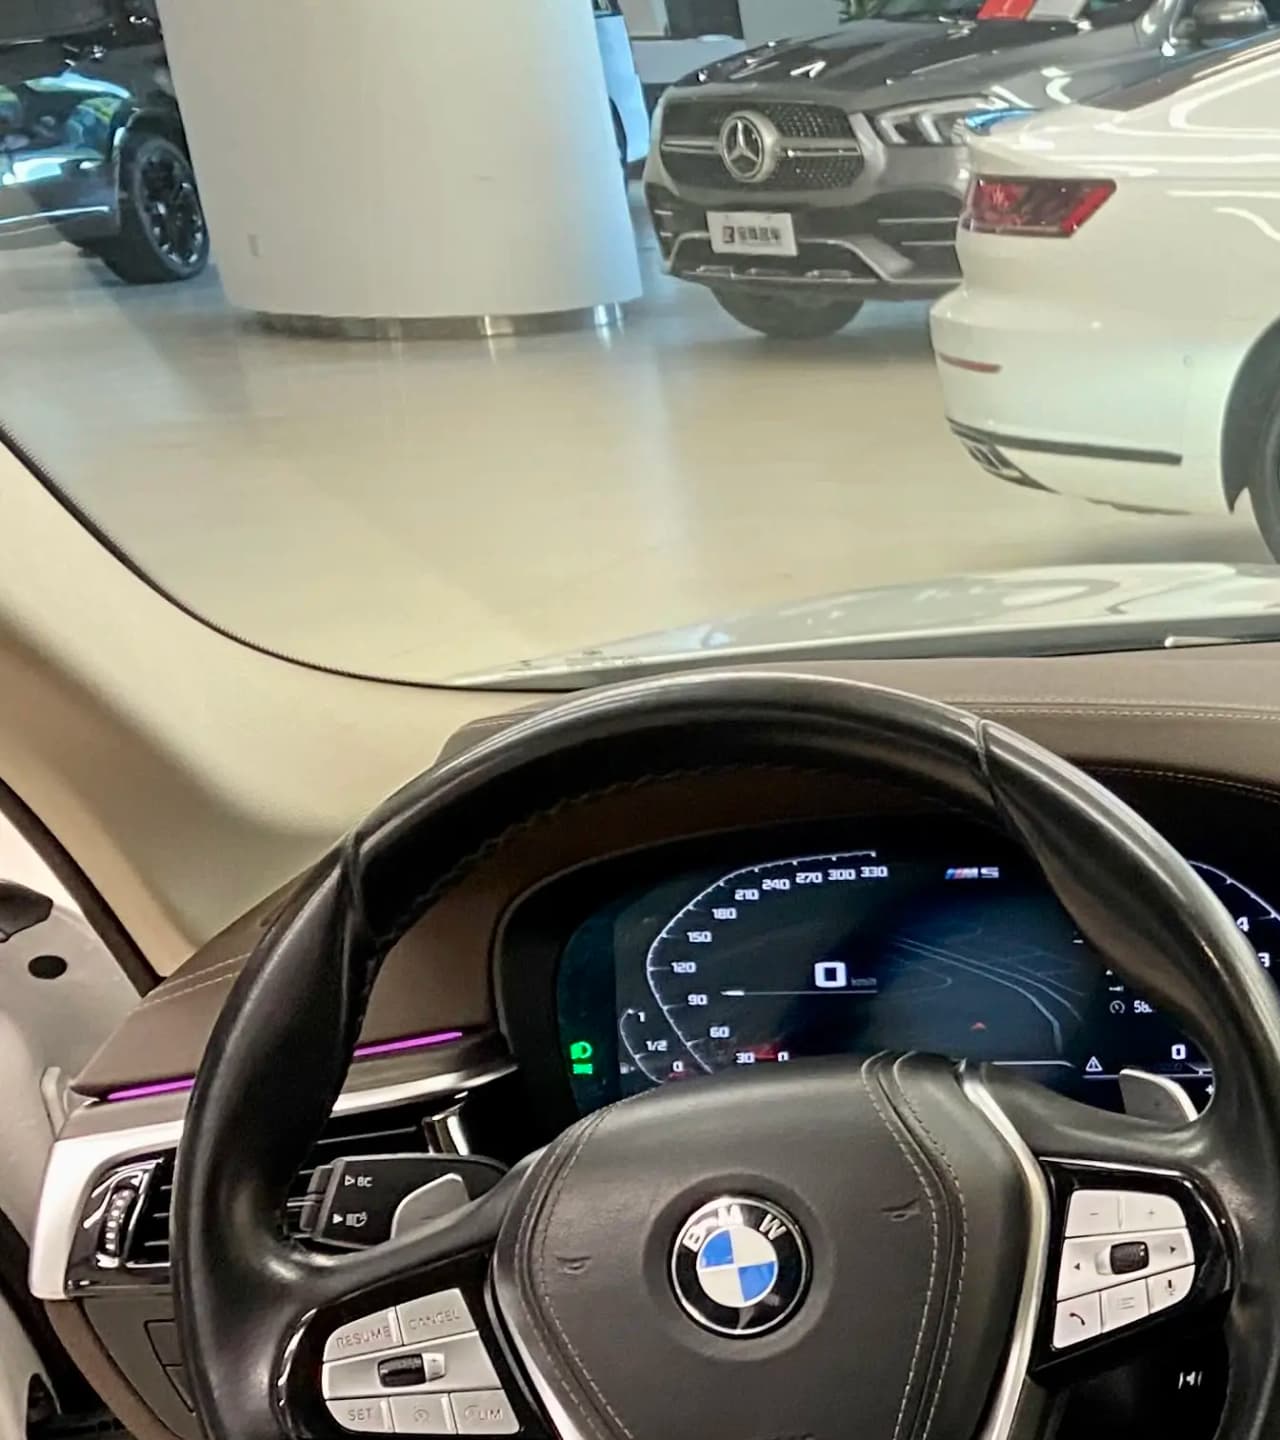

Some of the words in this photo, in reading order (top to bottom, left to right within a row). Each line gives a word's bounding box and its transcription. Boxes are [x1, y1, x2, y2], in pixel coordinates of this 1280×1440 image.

[796, 871, 823, 884] 270
[827, 869, 856, 881] 300
[860, 866, 888, 878] 330
[762, 879, 790, 891] 240
[734, 888, 759, 900] 210
[712, 907, 737, 919] 180
[687, 931, 712, 943] 150
[671, 961, 697, 973] 120
[814, 961, 847, 988] 0
[687, 994, 708, 1006] 90
[709, 1026, 730, 1038] 60
[646, 1040, 668, 1051] 1/2
[736, 1052, 755, 1064] 30
[1171, 1044, 1186, 1060] 0
[682, 1204, 787, 1252] BMW
[408, 1310, 461, 1331] CANCEL
[336, 1326, 392, 1349] RESUME
[348, 1408, 374, 1422] SET
[479, 1408, 503, 1421] LIM
